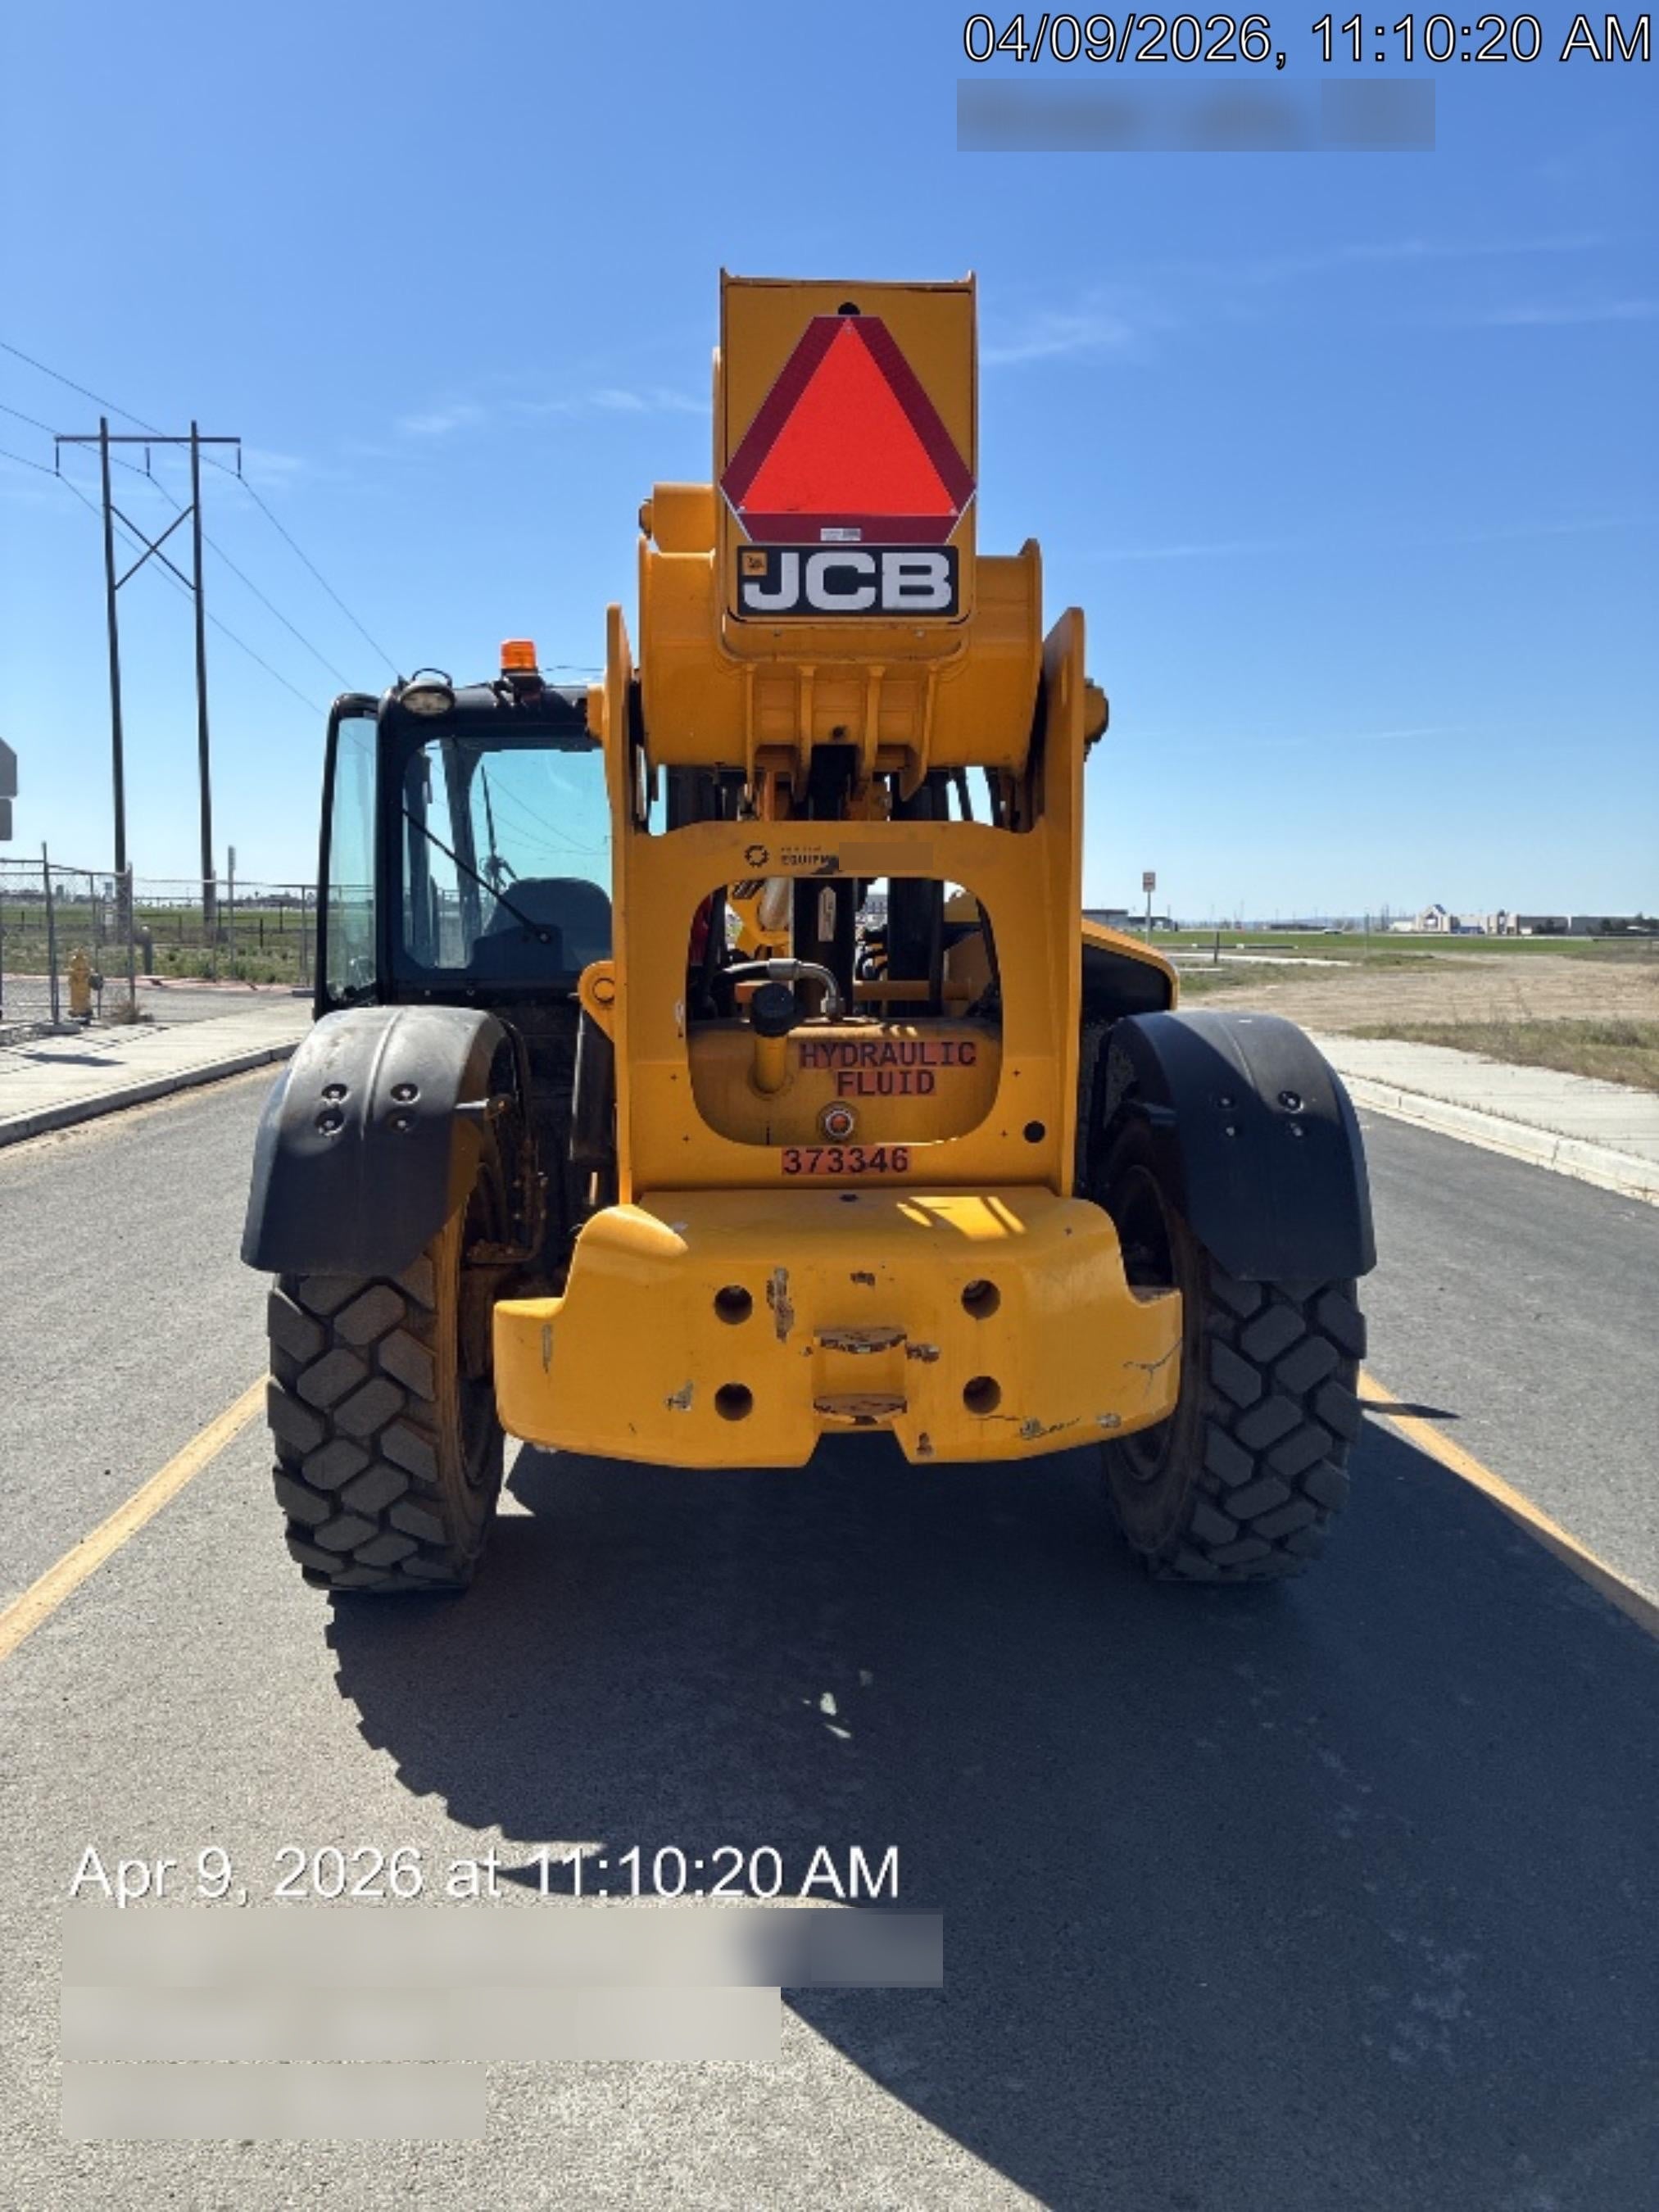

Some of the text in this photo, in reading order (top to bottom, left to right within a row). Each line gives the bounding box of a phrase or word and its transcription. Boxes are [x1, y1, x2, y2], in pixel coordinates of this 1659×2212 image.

[743, 552, 952, 610] JCB
[800, 1041, 977, 1067] HYDRAULIC
[837, 1071, 936, 1096] FLUID
[784, 1148, 909, 1173] 373346
